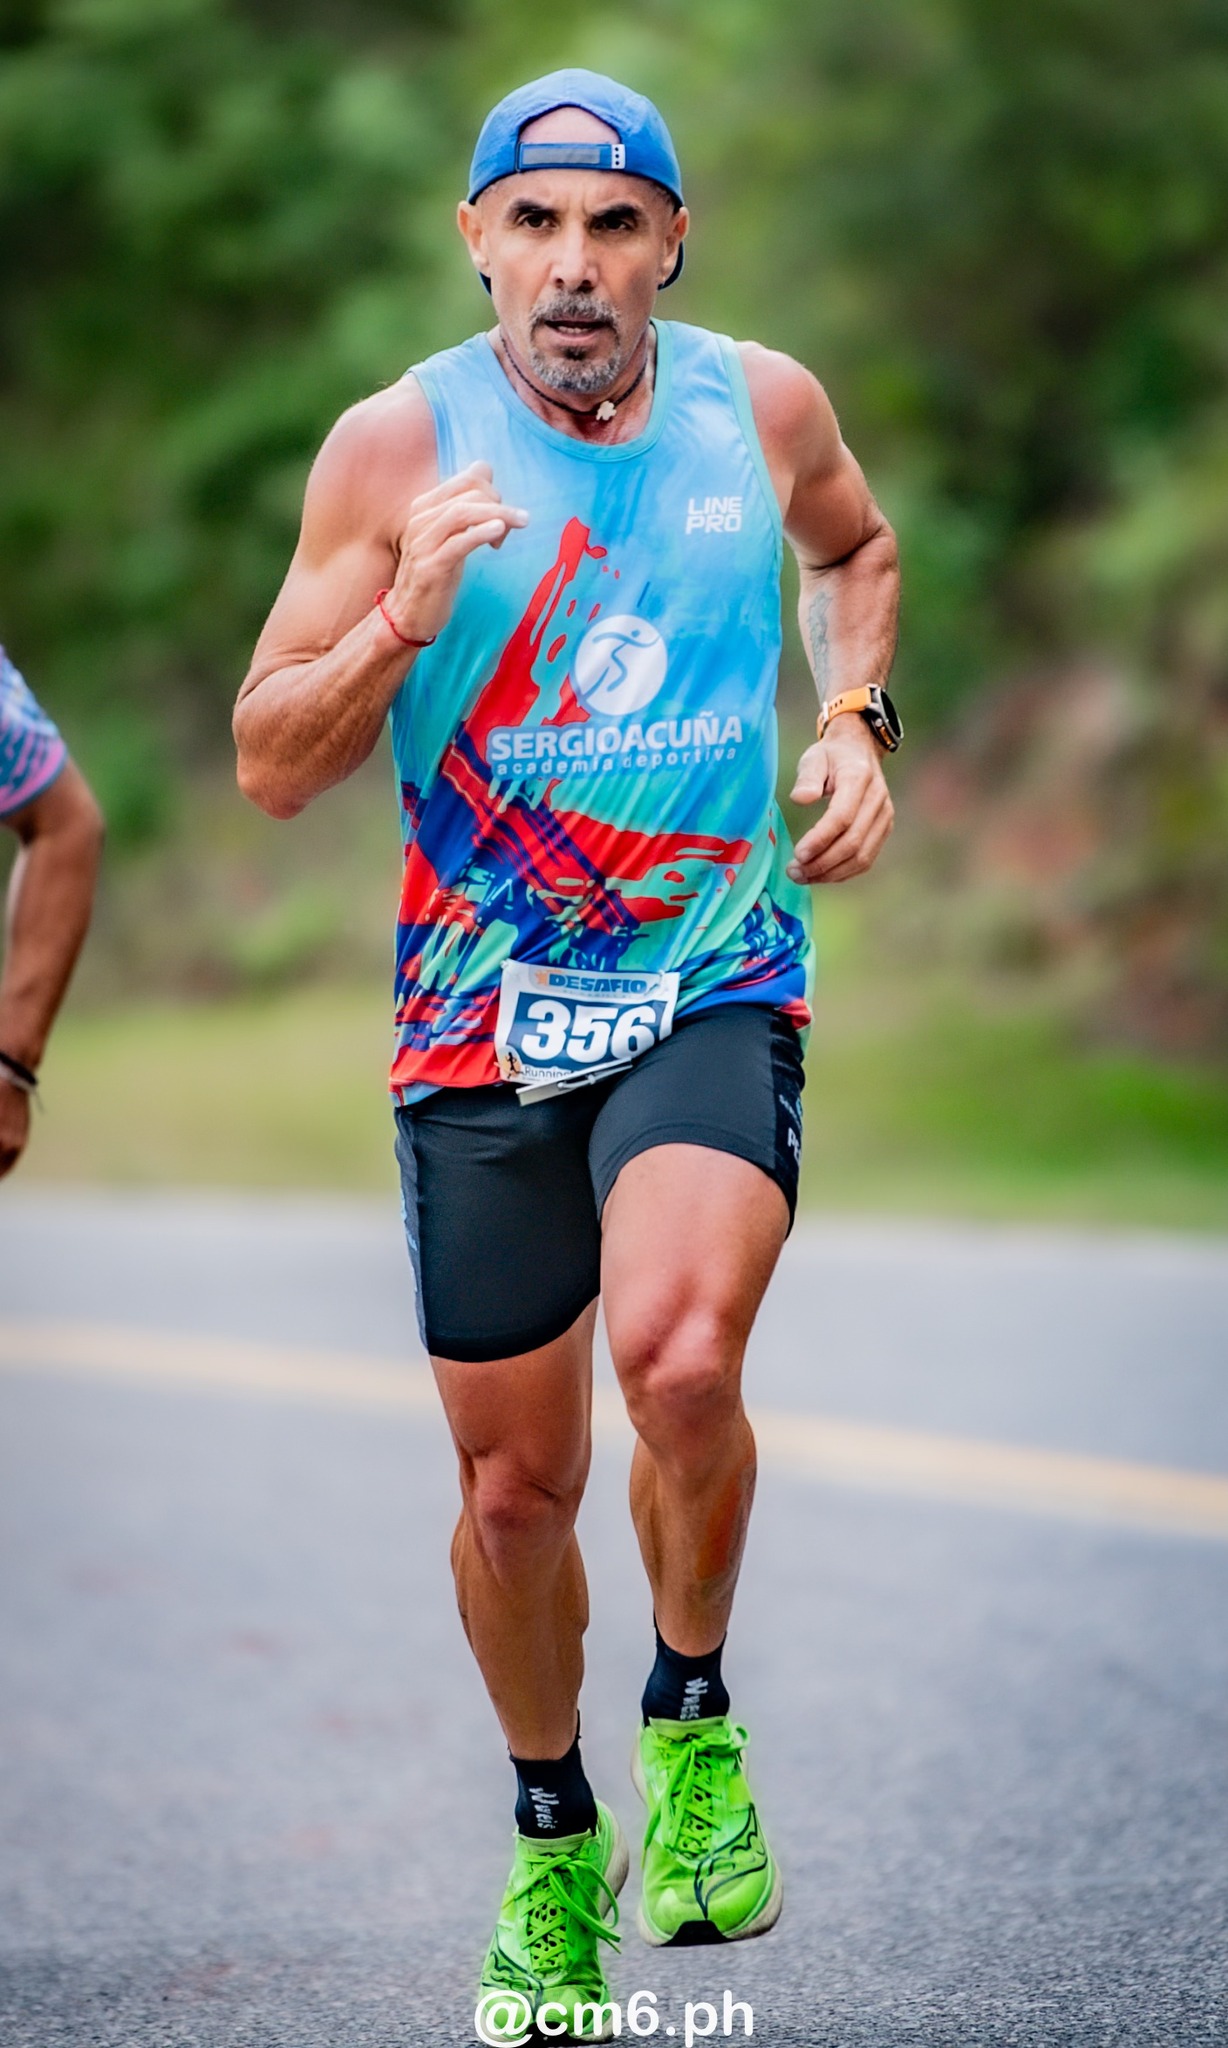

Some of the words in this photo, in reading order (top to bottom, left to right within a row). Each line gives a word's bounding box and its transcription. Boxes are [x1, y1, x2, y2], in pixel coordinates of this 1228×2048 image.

[688, 496, 743, 515] LINE
[685, 514, 742, 534] PRO
[497, 756, 613, 775] academia
[623, 745, 736, 769] deportiva
[521, 1000, 656, 1063] 356
